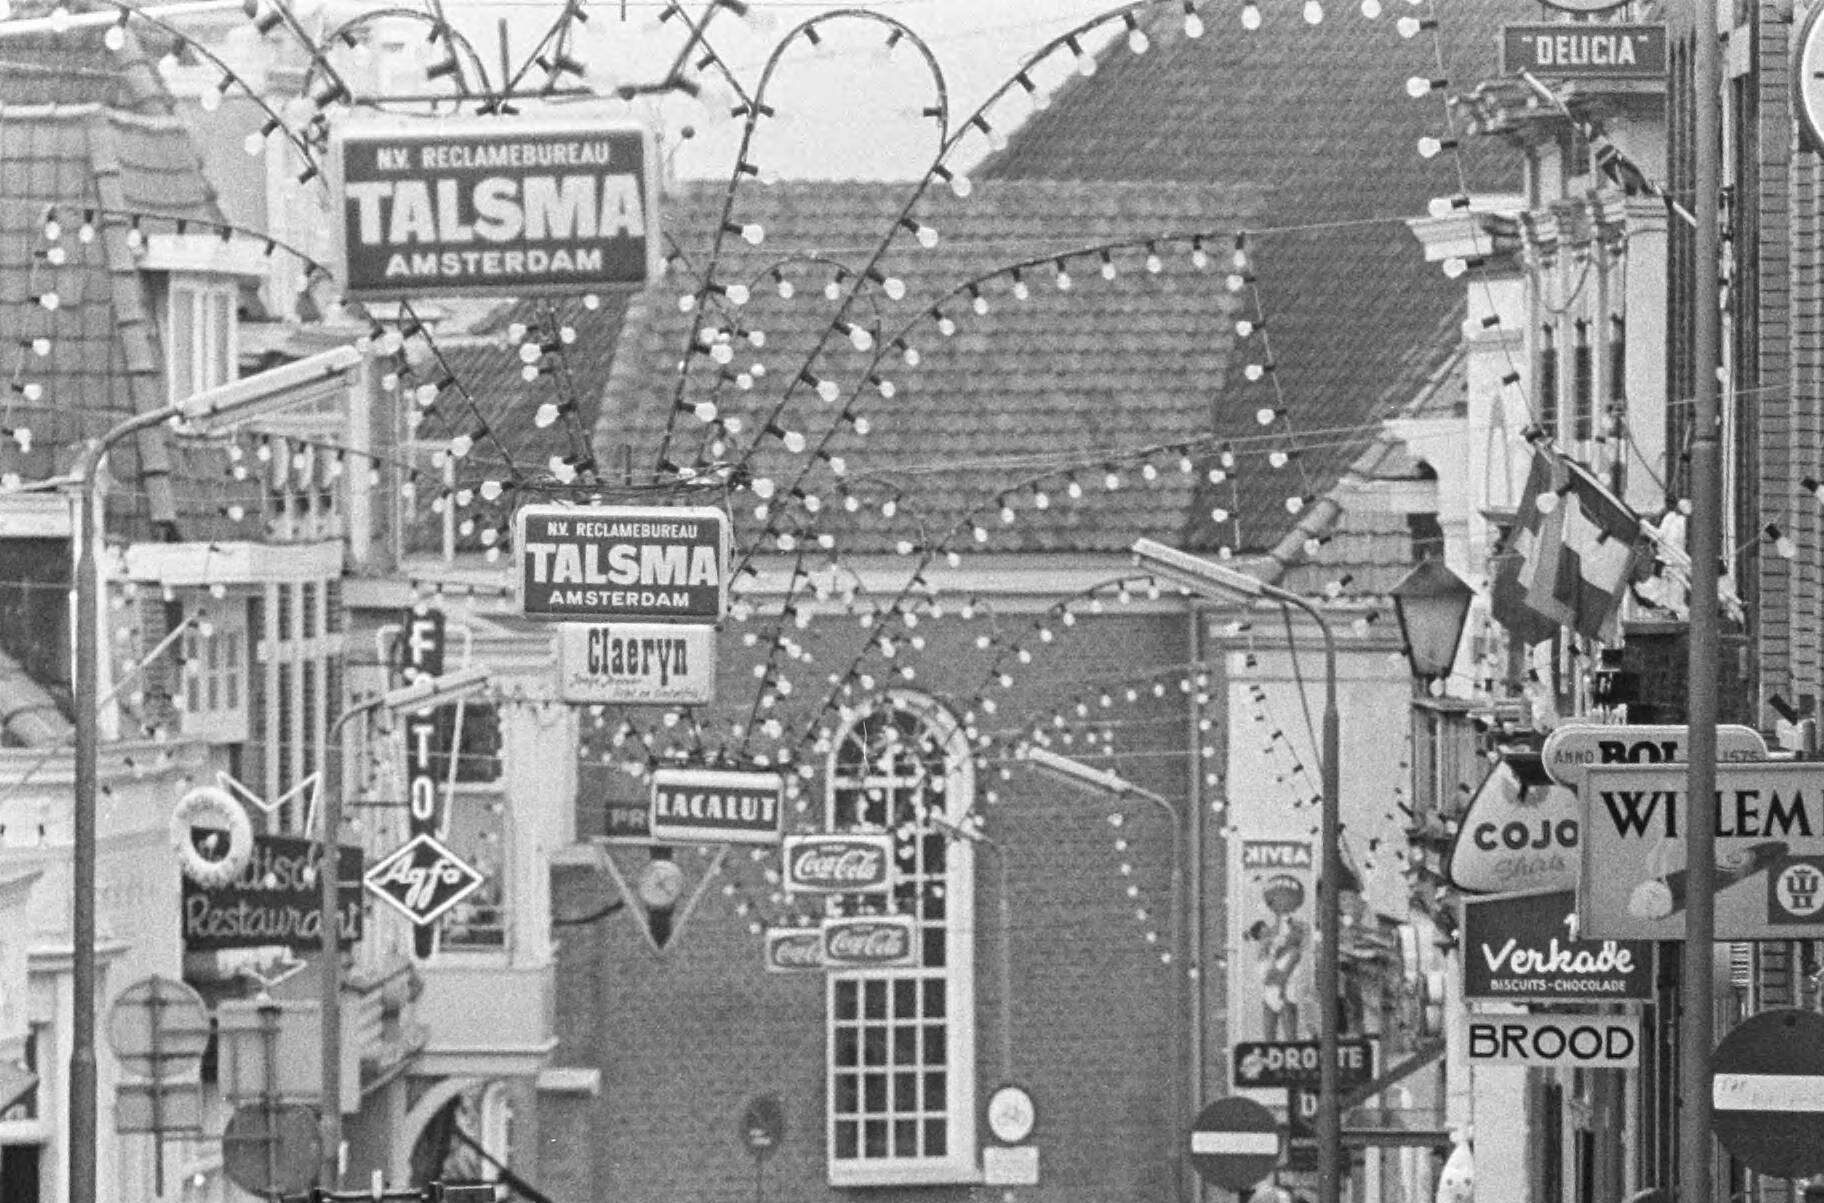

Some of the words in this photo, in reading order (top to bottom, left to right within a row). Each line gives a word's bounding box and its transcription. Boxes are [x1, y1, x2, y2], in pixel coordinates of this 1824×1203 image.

[377, 148, 410, 170] N.V.
[421, 142, 610, 168] RECLAMEBUREAU
[346, 173, 645, 244] TALSMA
[385, 249, 602, 277] AMSTERDAM
[576, 522, 698, 539] RECLAMEBUREAU
[526, 543, 719, 586] TALSMA
[550, 591, 690, 607] AMSTERDAM
[588, 628, 688, 686] Claeryn
[657, 792, 775, 822] LACALUT
[1600, 788, 1814, 838] WILEM
[373, 851, 462, 909] Agfa
[187, 894, 360, 939] Restaurat
[1481, 937, 1636, 974] Verkade
[1268, 1047, 1364, 1071] DROTE
[1468, 1023, 1635, 1061] BROOD
